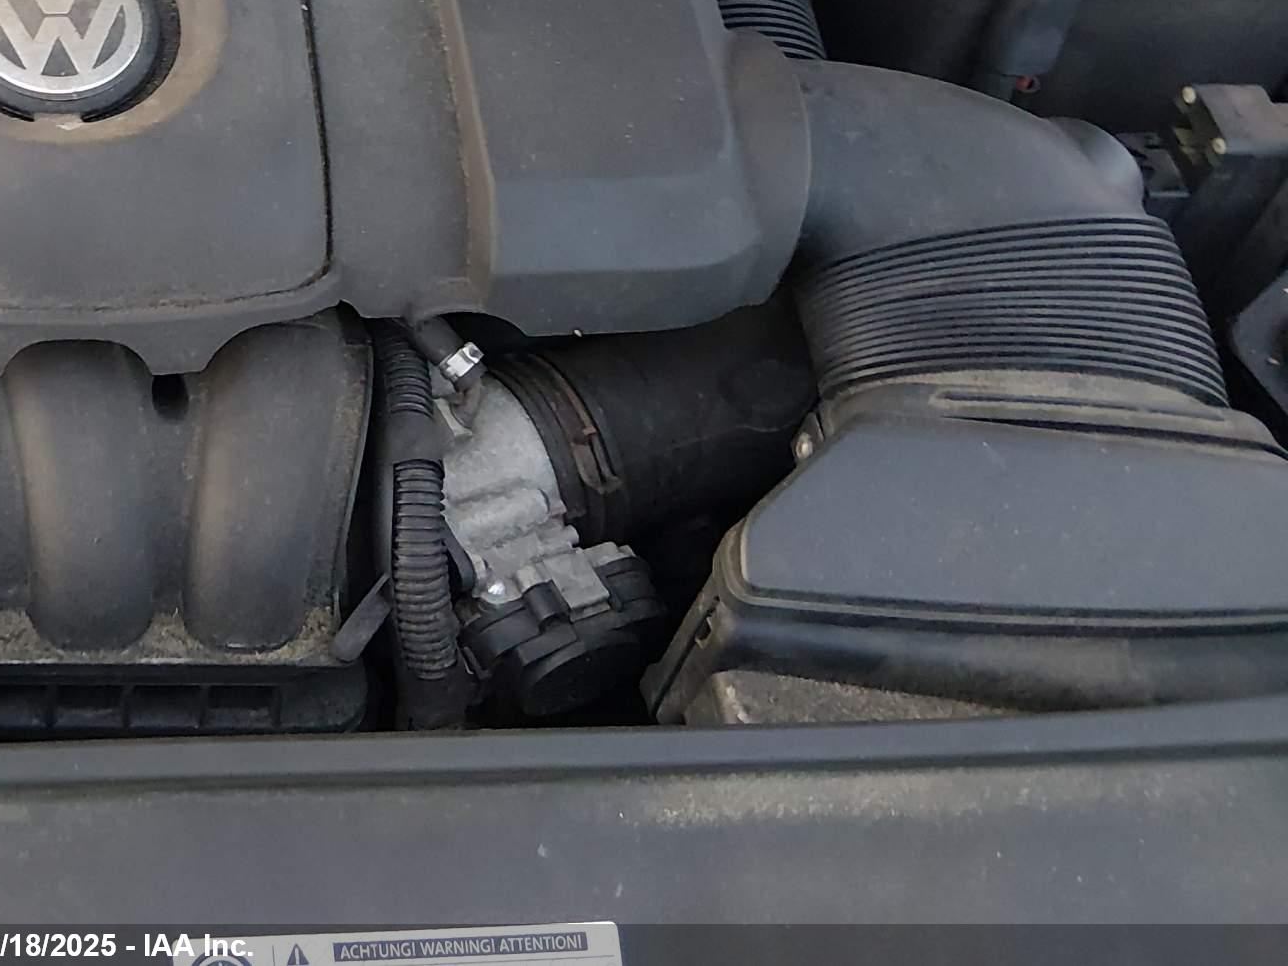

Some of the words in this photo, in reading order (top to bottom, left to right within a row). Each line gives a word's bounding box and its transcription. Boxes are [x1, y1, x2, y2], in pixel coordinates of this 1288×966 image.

[339, 942, 416, 961] ACHTUNG!
[420, 938, 496, 957] WARNING!
[498, 933, 583, 953] ATTENTION!
